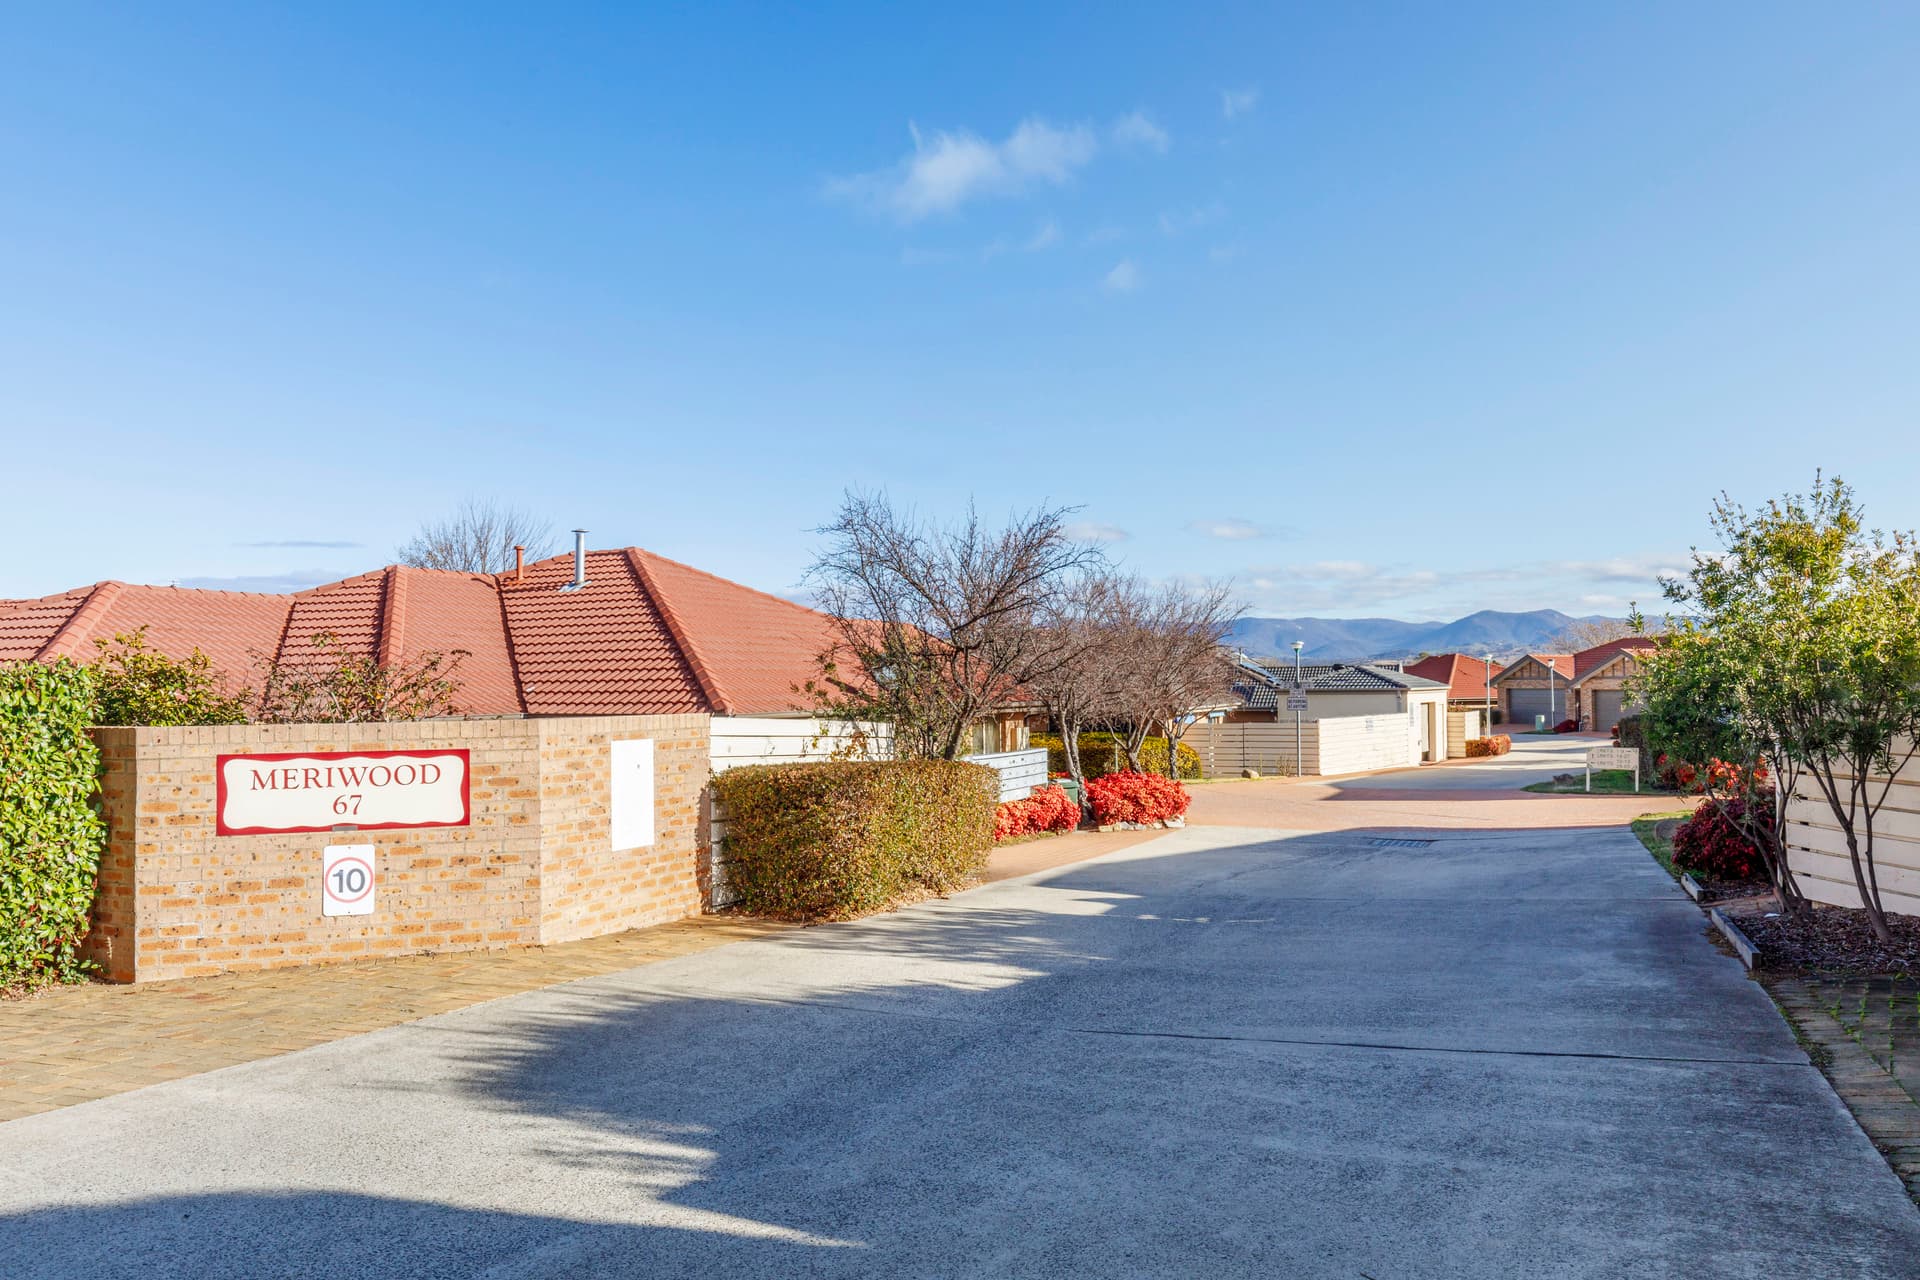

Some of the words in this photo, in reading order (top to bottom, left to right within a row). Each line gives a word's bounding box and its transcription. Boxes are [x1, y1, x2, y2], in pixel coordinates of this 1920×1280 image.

[250, 763, 442, 791] MERIWOOD
[332, 794, 363, 816] 67
[332, 867, 366, 894] 10
